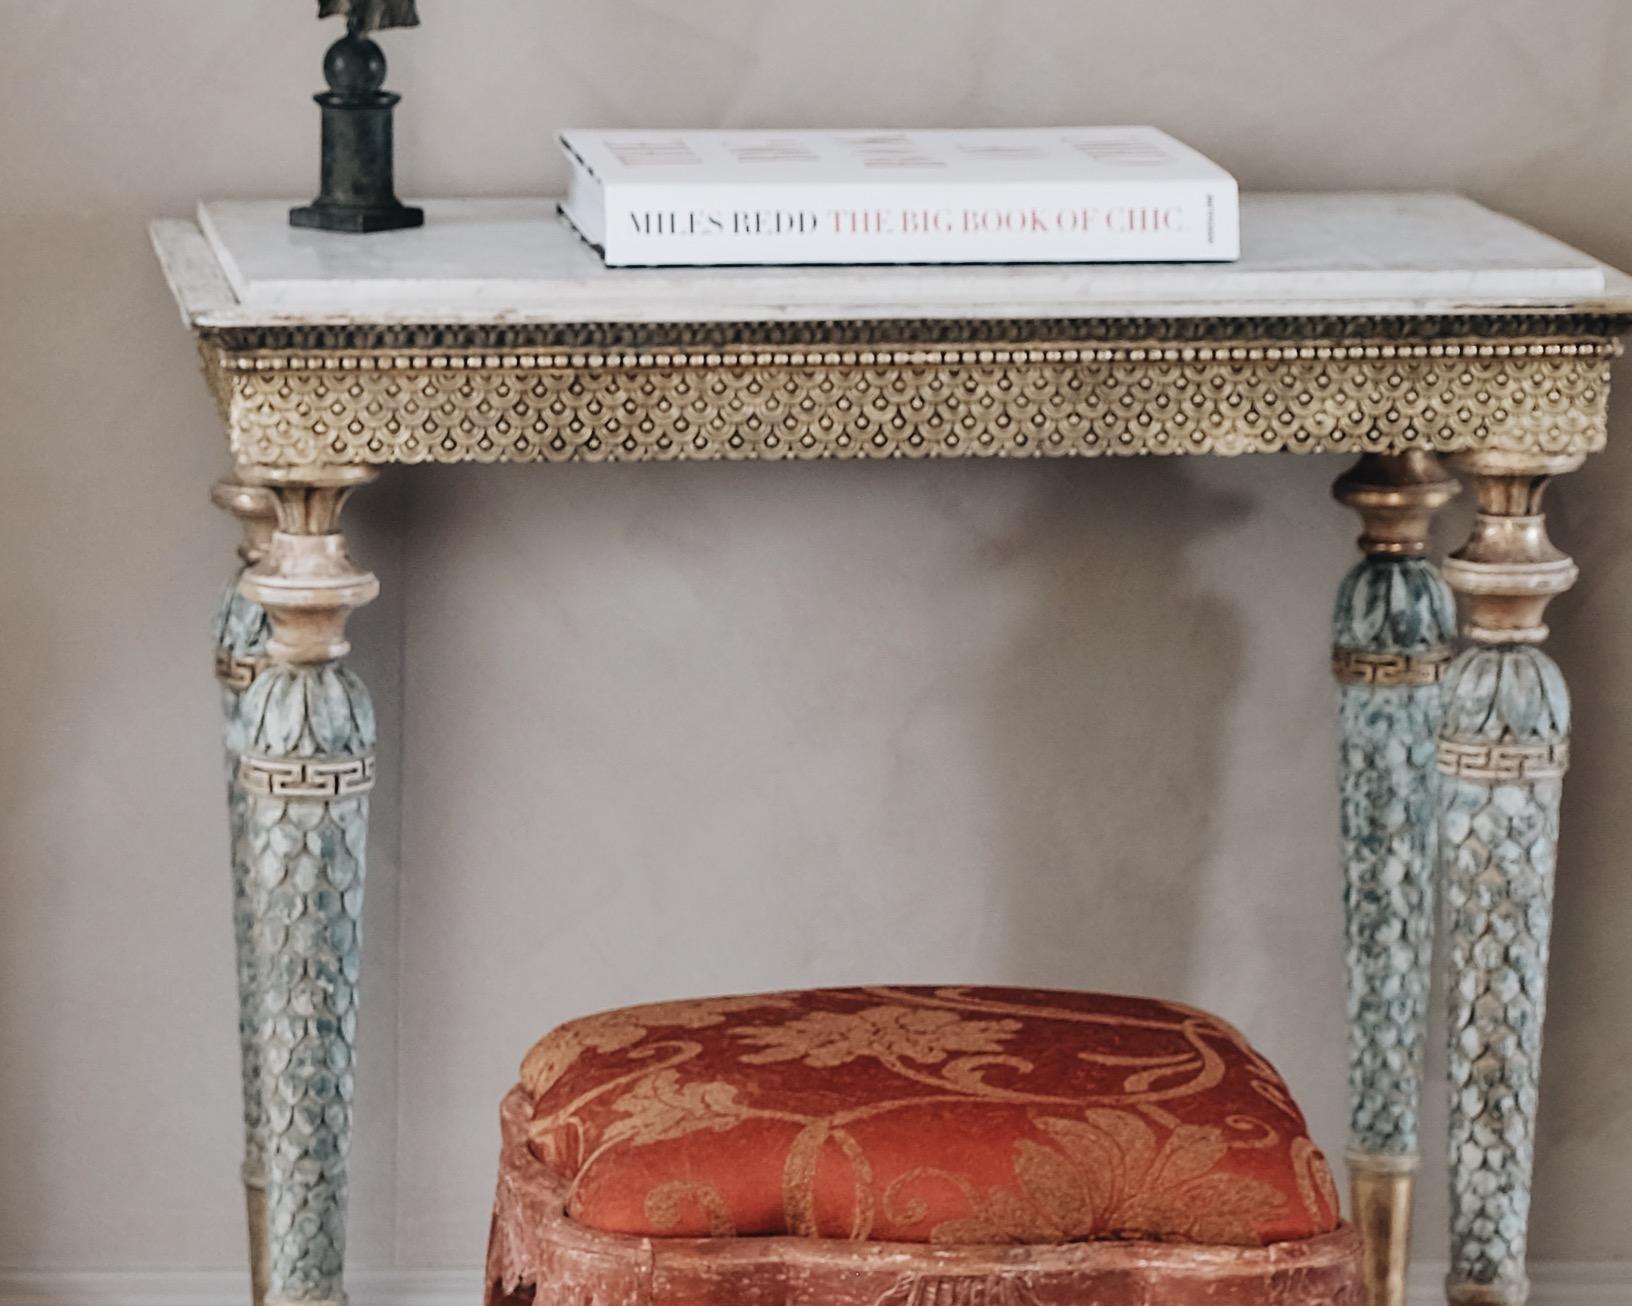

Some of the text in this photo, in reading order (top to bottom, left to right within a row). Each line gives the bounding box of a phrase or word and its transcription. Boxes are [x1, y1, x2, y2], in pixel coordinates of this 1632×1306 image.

[629, 211, 723, 235] MILES
[732, 210, 818, 234] REDD
[827, 209, 893, 233] THE
[901, 208, 953, 232] BIG
[963, 207, 1049, 232] BOOK
[1056, 207, 1099, 231] OF
[1105, 206, 1184, 231] CHIC
